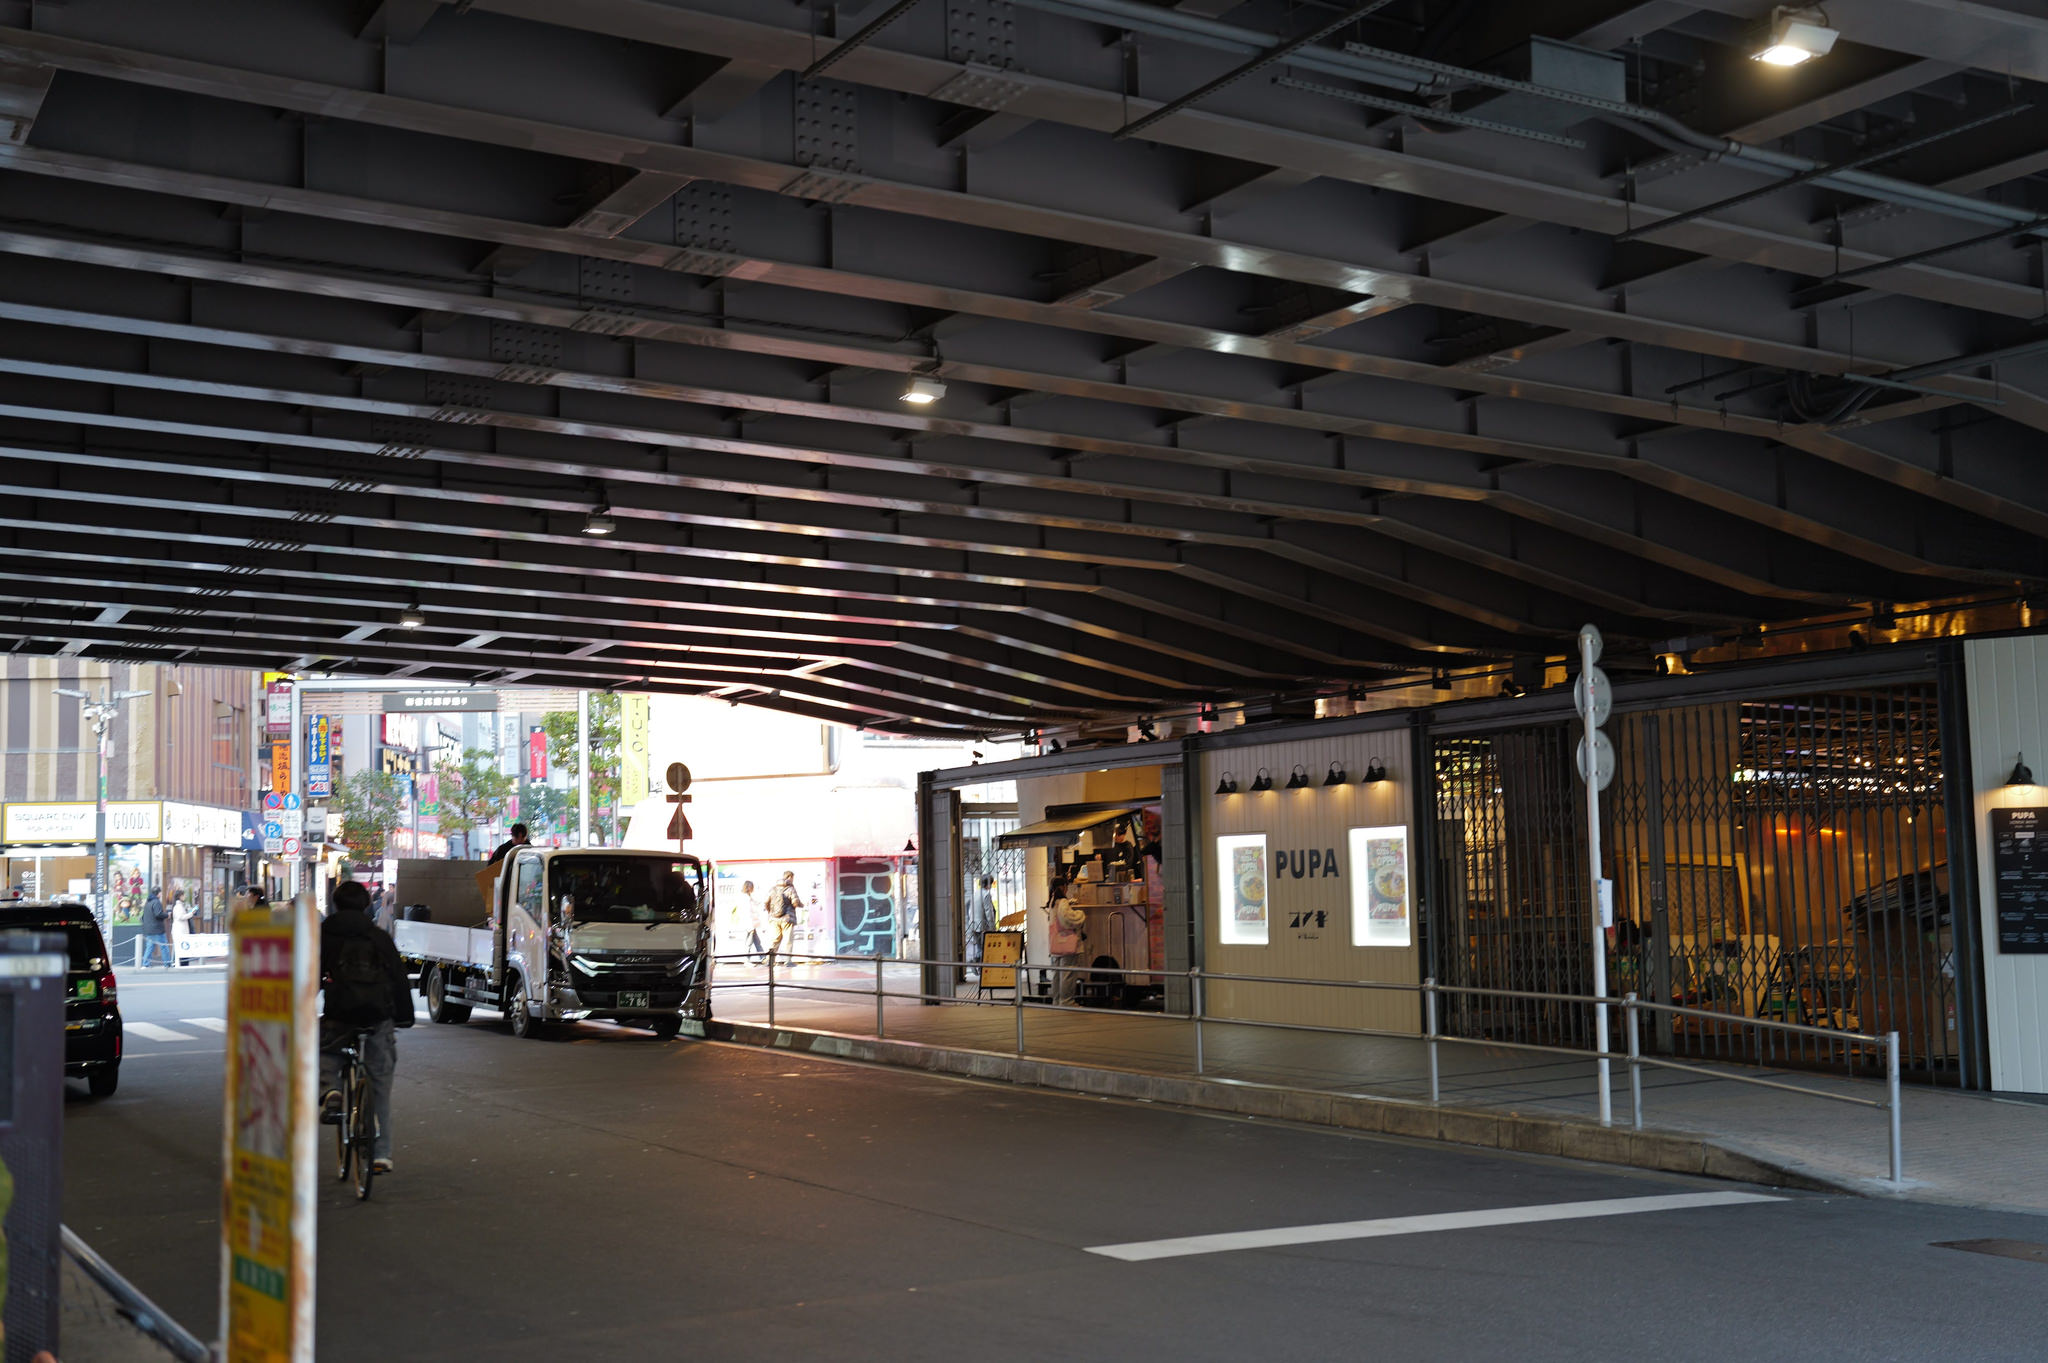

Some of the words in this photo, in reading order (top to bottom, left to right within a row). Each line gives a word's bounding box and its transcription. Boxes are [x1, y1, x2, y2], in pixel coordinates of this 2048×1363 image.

[113, 812, 151, 830] GOODS
[2011, 811, 2036, 819] PUPA
[1276, 848, 1339, 879] PUPA
